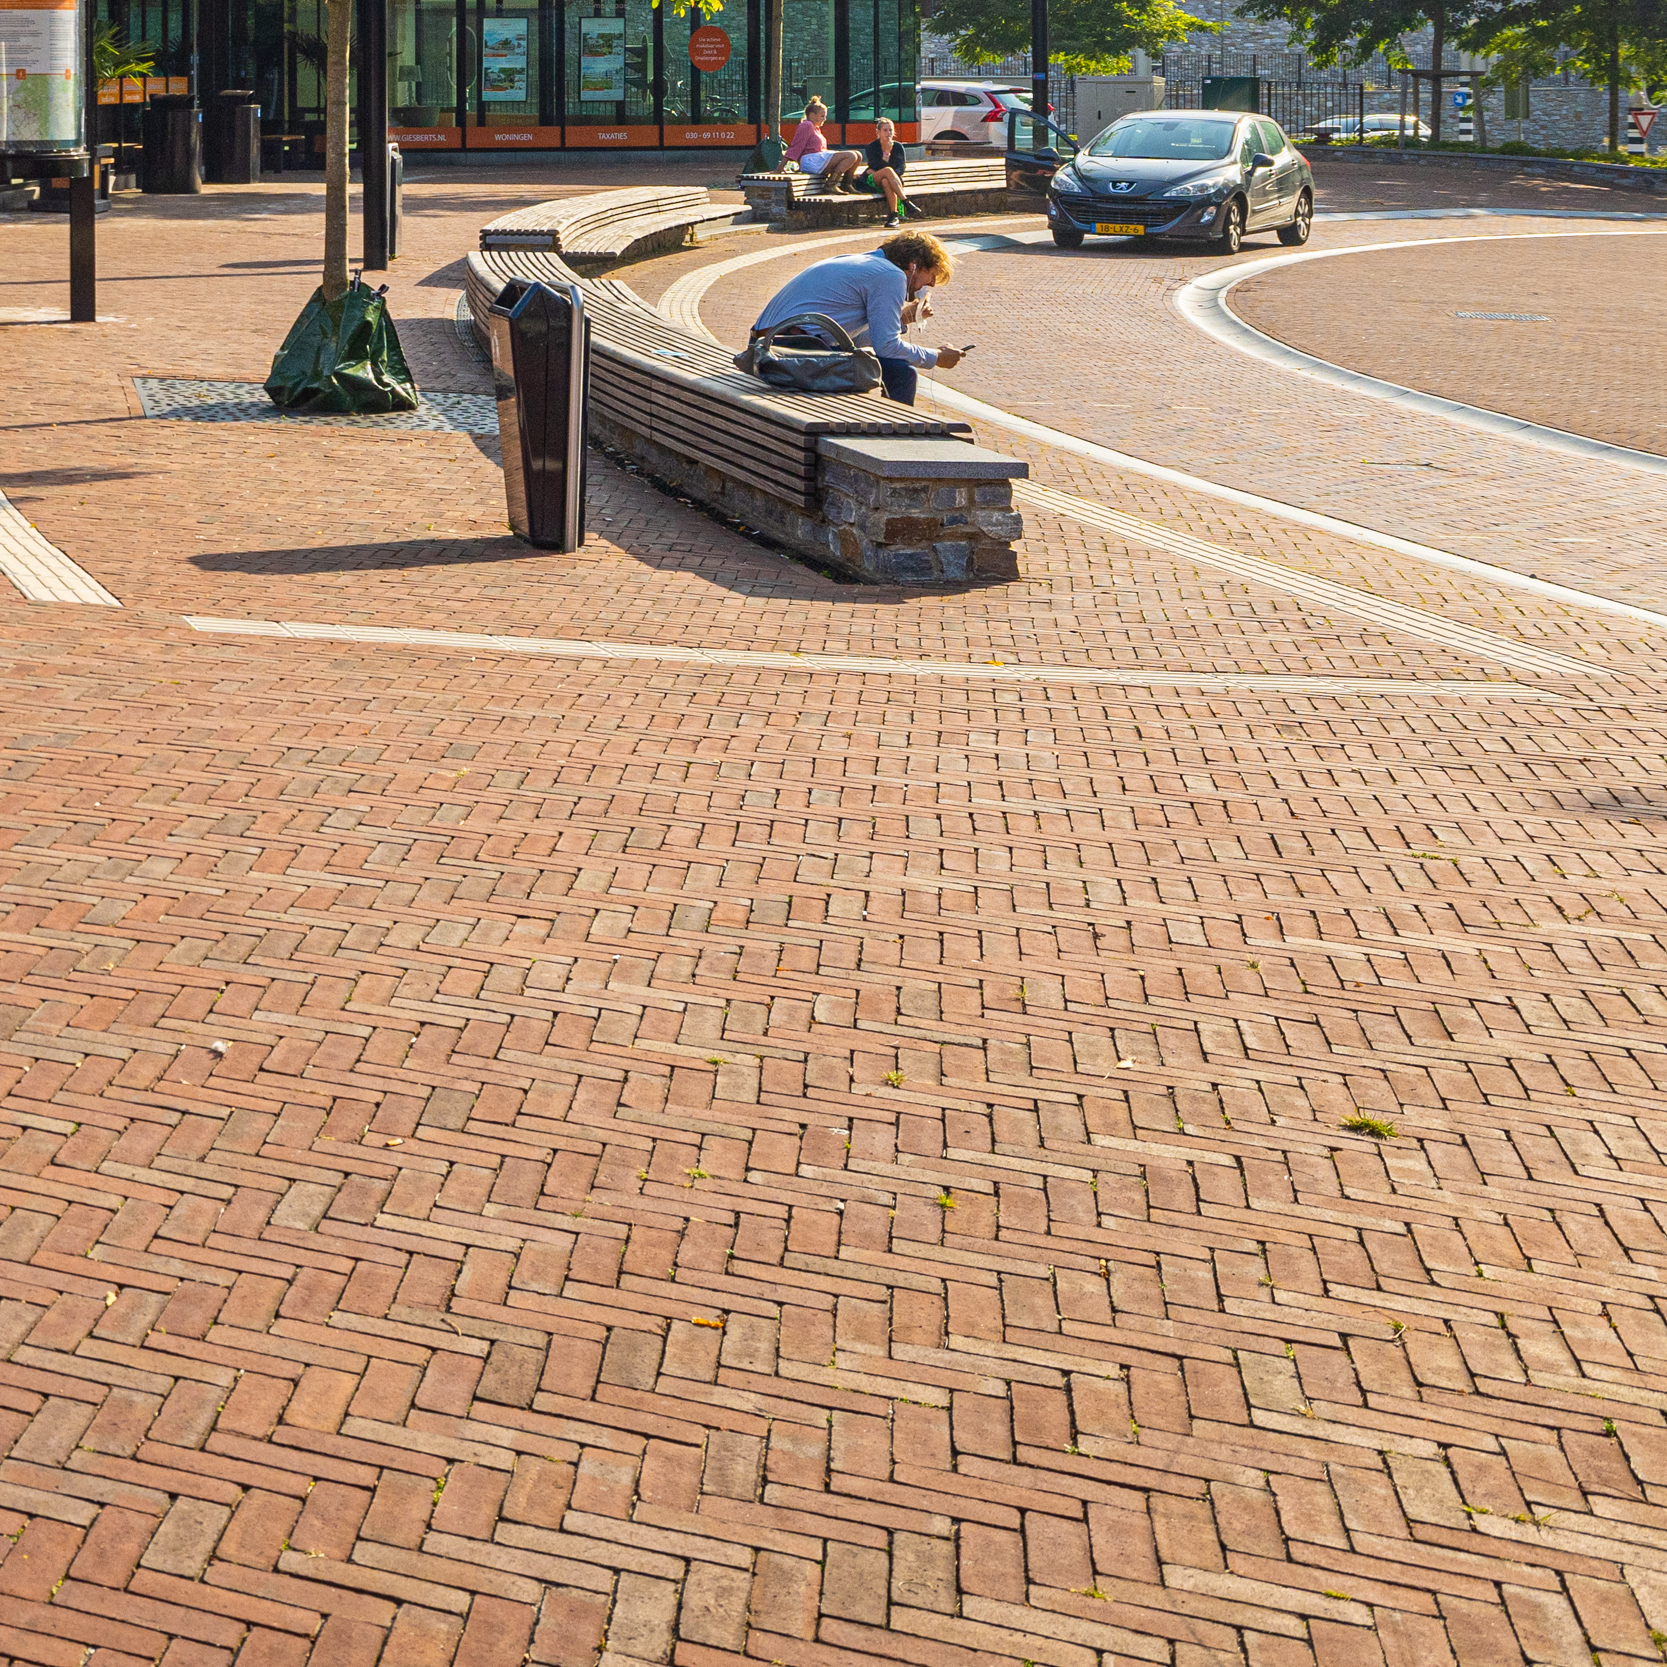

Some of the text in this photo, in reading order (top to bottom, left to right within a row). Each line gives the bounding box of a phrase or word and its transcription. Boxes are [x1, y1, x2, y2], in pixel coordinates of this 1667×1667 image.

[387, 134, 447, 142] WW.GIESBERTS.NL
[494, 133, 533, 141] WONINGEN
[597, 132, 628, 140] TAXATIES
[726, 131, 735, 139] 22
[1100, 224, 1139, 234] 18-LXZ-6
